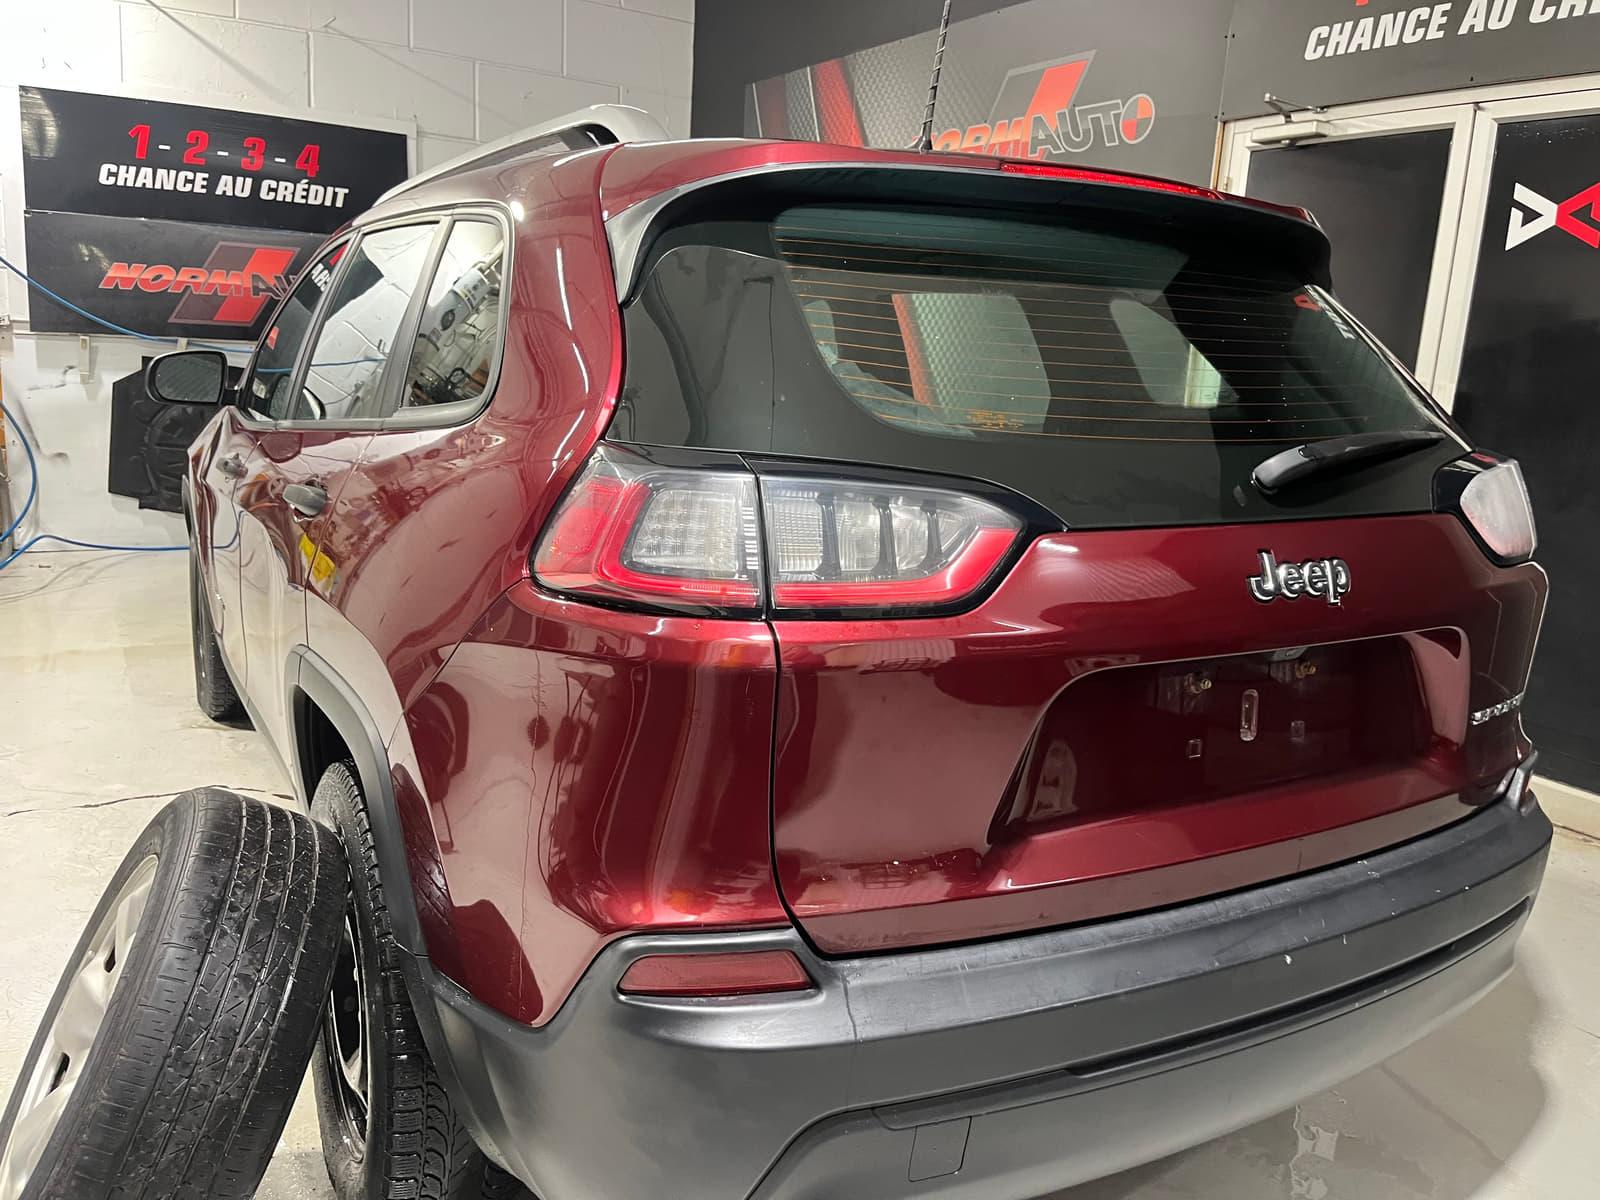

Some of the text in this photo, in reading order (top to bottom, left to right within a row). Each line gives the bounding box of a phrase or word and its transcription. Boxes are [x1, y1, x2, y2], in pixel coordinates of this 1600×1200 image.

[1304, 2, 1452, 61] CHANCE
[1457, 0, 1518, 35] AU
[98, 163, 349, 208] CHANCE AU CRÉDIT
[1246, 549, 1351, 605] Jeep
